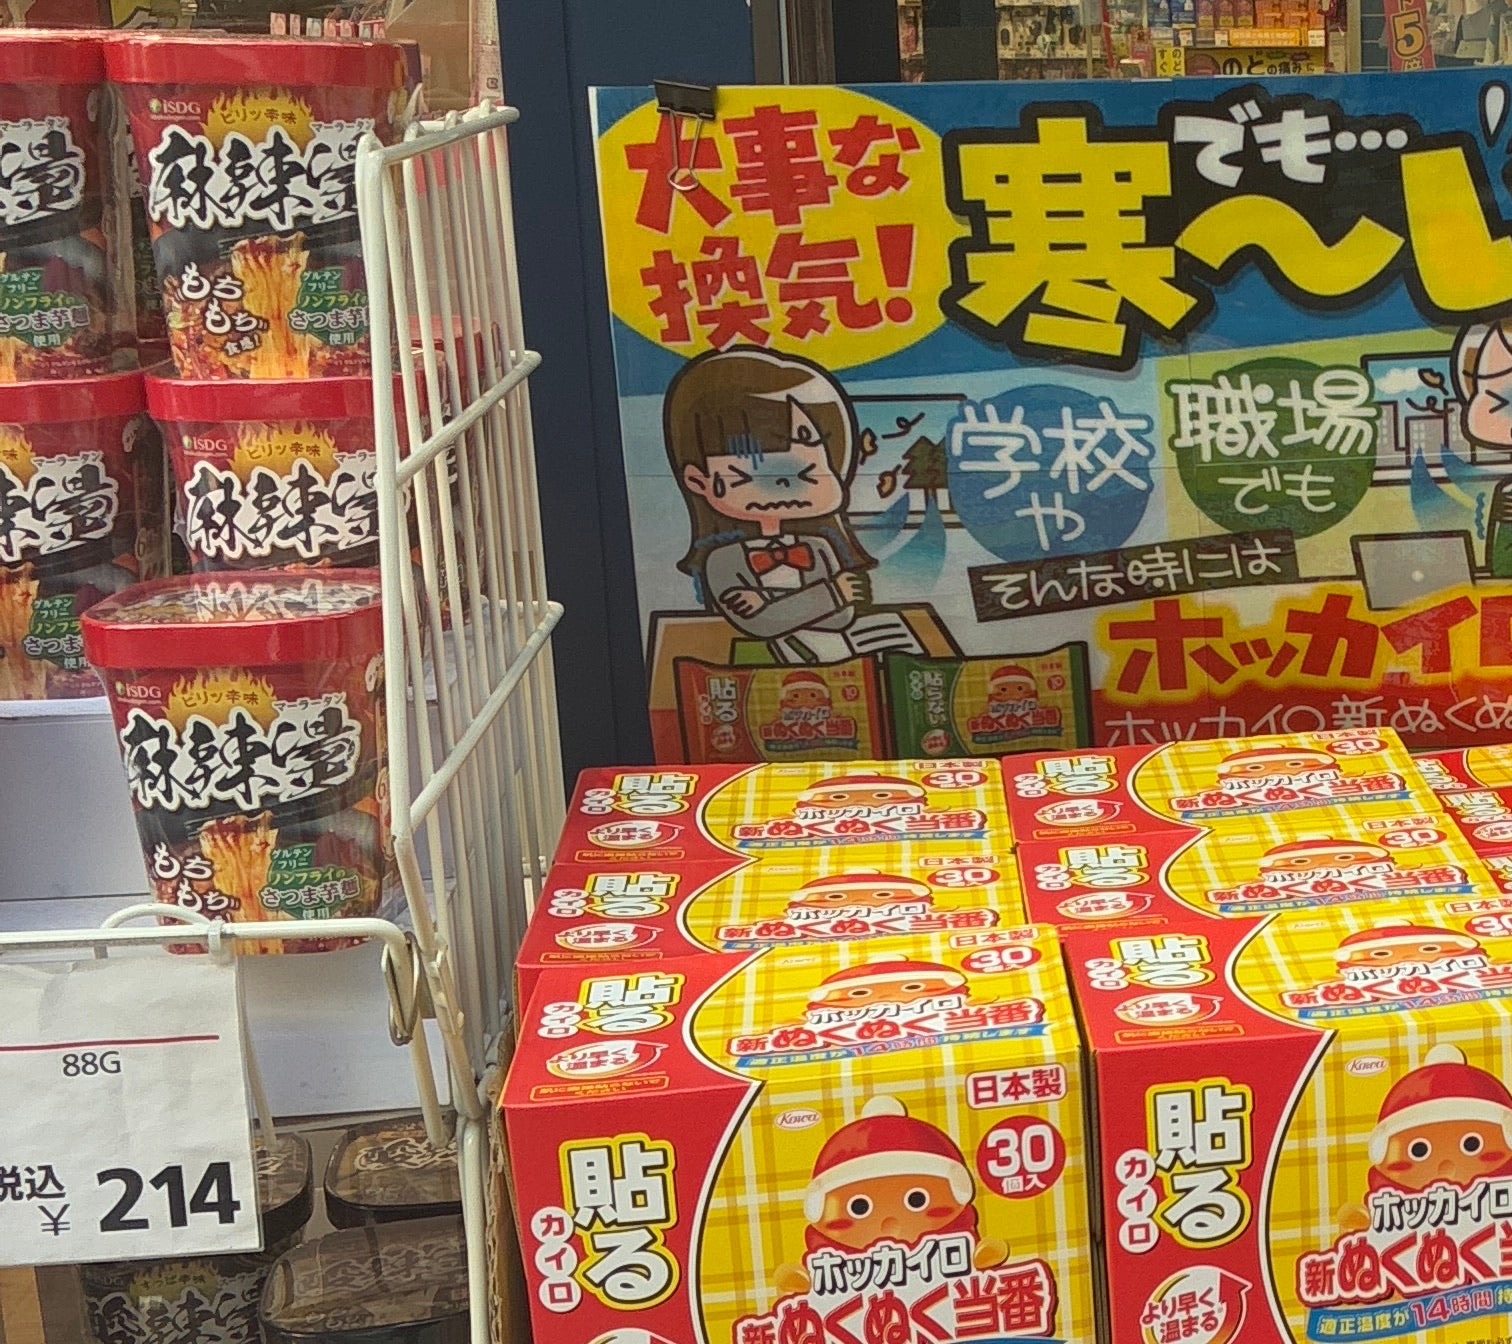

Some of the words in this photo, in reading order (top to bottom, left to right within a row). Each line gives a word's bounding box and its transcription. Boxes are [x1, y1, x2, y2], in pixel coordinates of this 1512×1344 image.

[623, 104, 923, 233] 大事な
[642, 224, 916, 351] 換気!
[948, 384, 1157, 492] 学校
[1173, 367, 1378, 460] 職場
[1218, 462, 1340, 514] でも
[1024, 492, 1088, 546] や
[980, 541, 1284, 612] そんな時には
[275, 693, 347, 712] マーラータン
[709, 677, 739, 723] 貼る
[269, 869, 346, 884] ノンフライの
[62, 1050, 122, 1077] 88G
[971, 1067, 1062, 1105] 日本製
[986, 1124, 1056, 1175] 30
[1155, 1086, 1245, 1245] 貼る
[39, 1202, 71, 1237] ¥
[97, 1161, 241, 1235] 214
[1001, 1173, 1044, 1194] 個入
[540, 1211, 576, 1309] カイロ
[568, 1141, 672, 1304] 貼る
[811, 1234, 971, 1296] ホッカイロ
